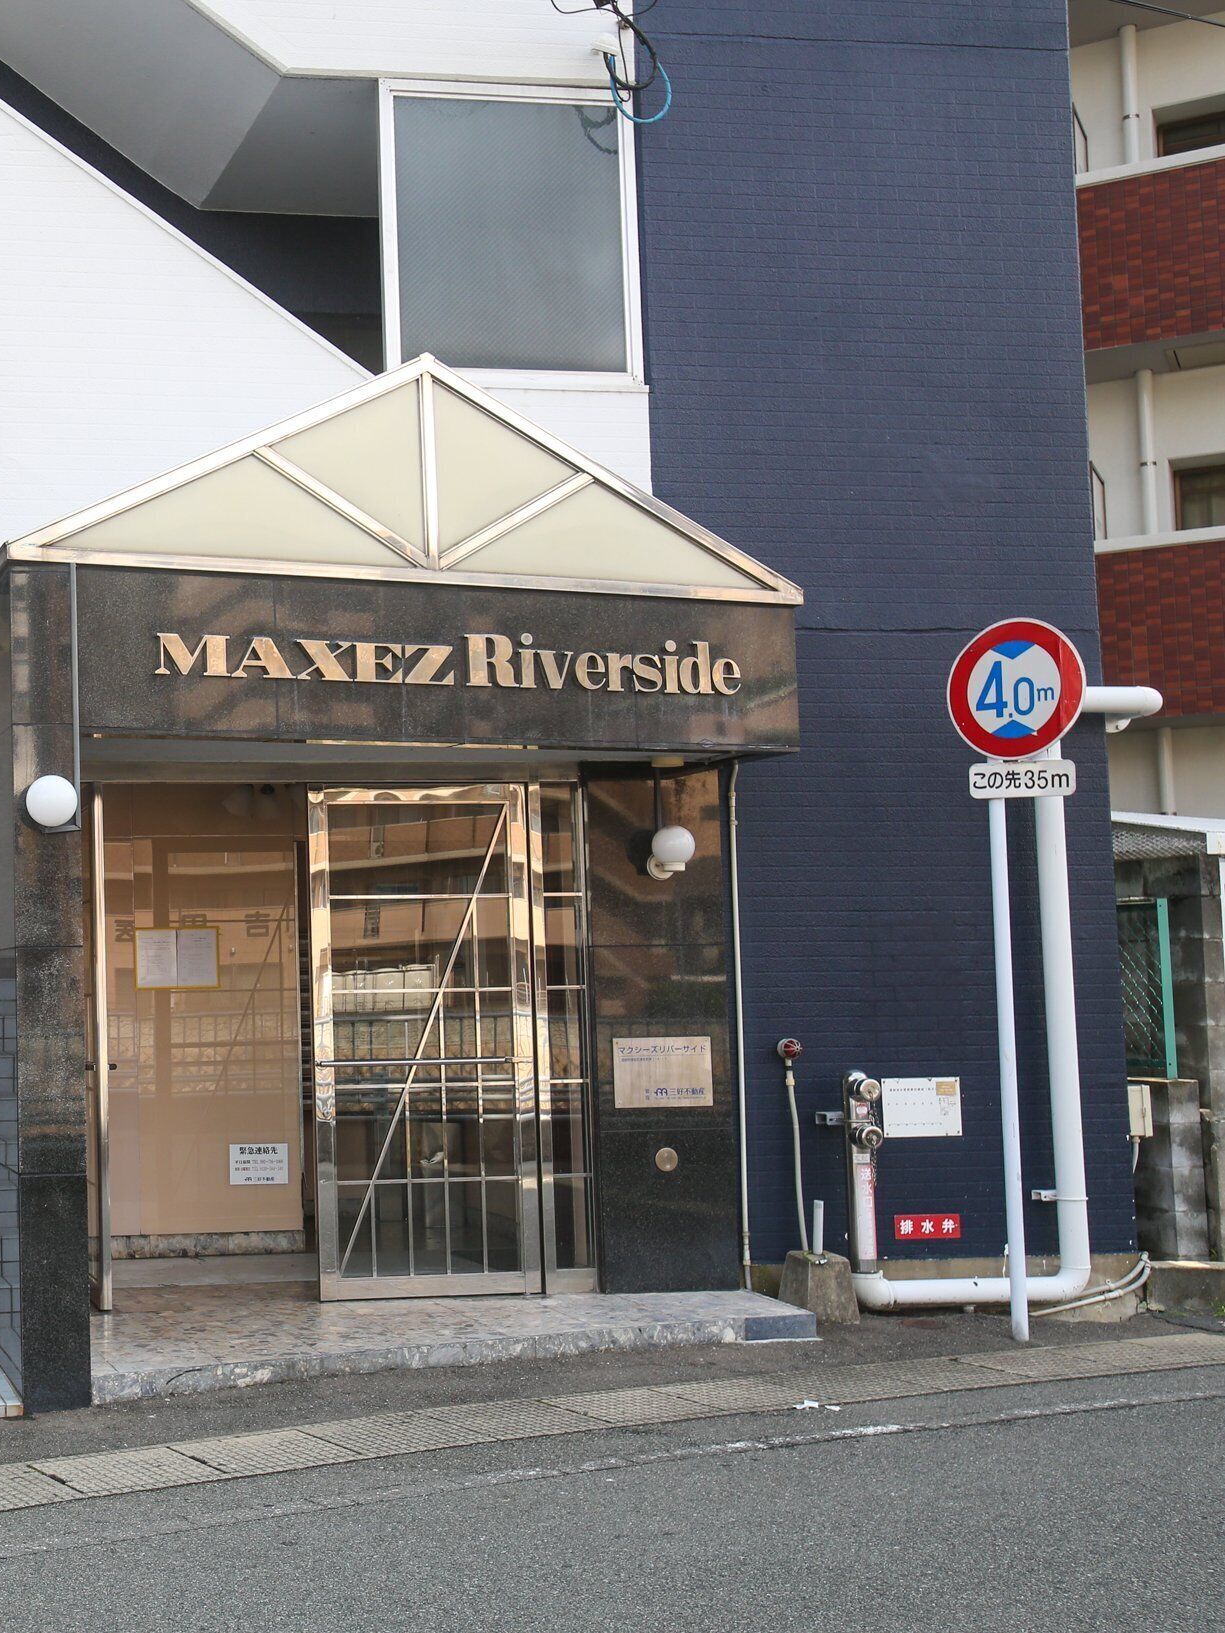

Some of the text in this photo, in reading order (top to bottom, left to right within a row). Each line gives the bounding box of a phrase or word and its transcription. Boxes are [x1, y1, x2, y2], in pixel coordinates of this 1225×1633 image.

[154, 632, 742, 696] MAXEZ Riverside
[972, 769, 1070, 790] この先35m
[618, 1045, 706, 1054] マクシーズリバーサイド
[239, 1146, 278, 1155] 緊急連絡先
[899, 1218, 956, 1235] 排水弁
